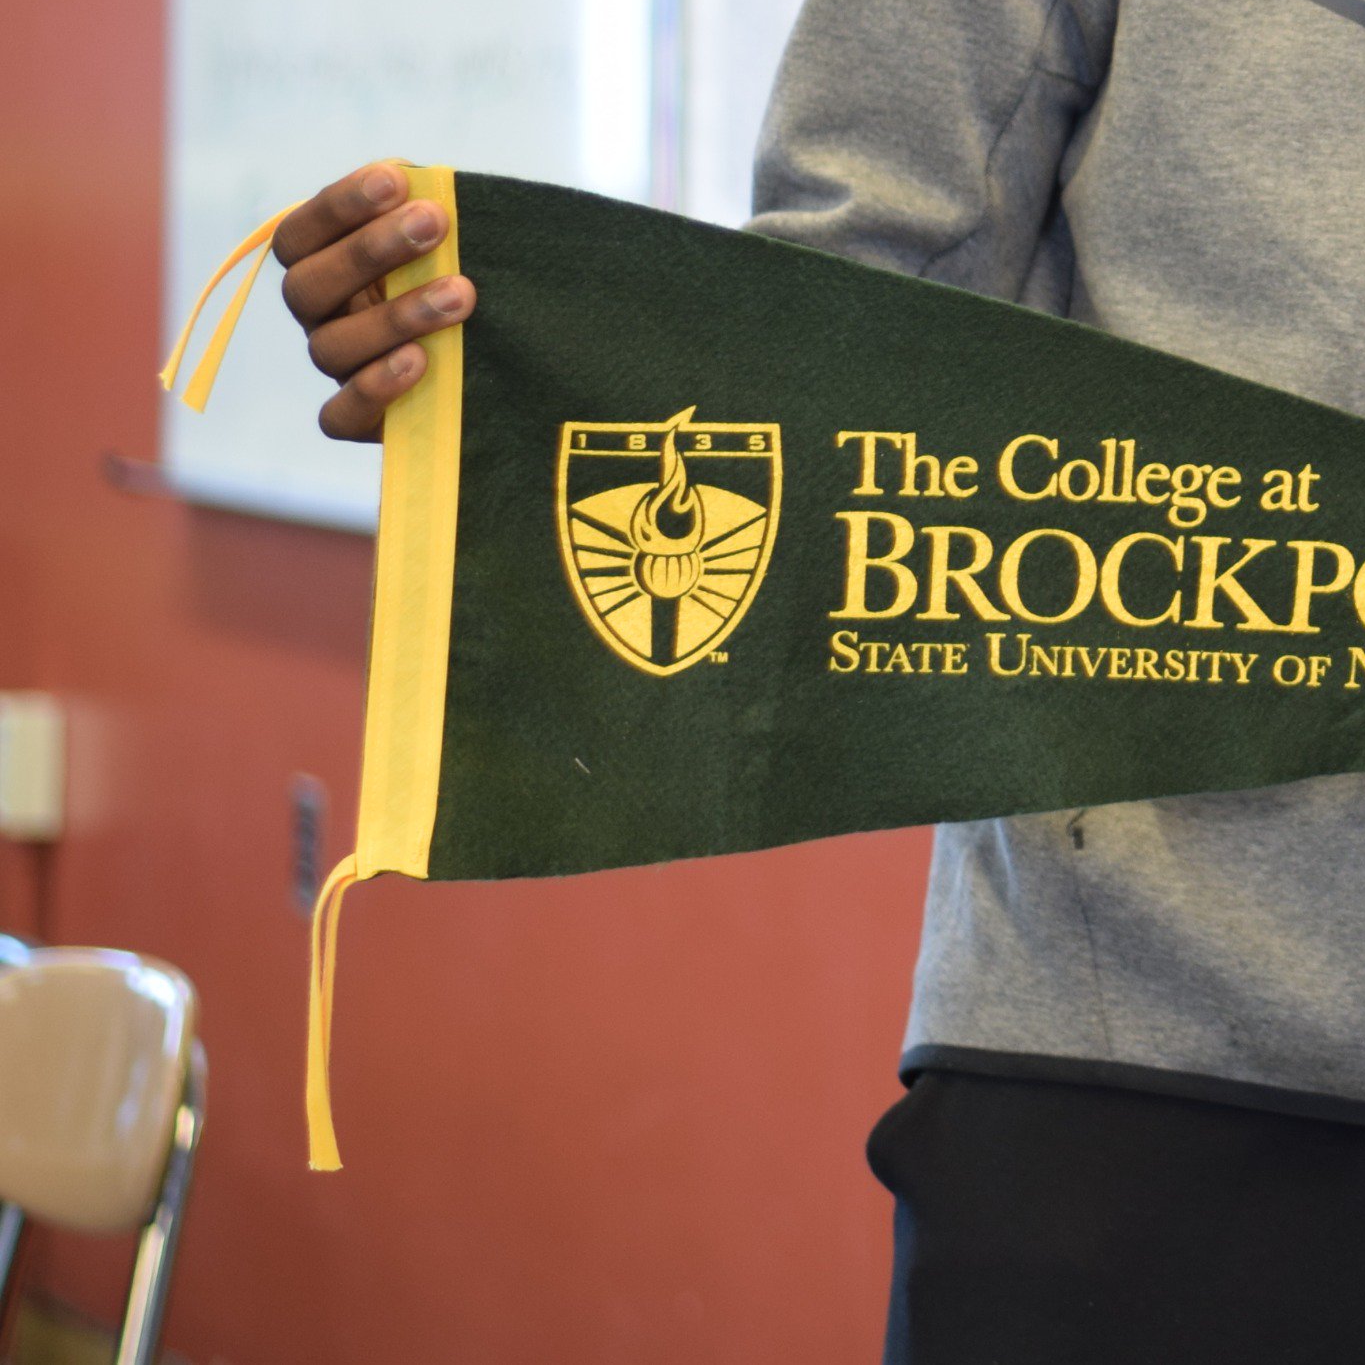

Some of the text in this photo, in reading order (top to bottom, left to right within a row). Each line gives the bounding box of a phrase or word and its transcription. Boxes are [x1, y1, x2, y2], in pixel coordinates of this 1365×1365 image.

[836, 430, 1320, 528] The College at
[828, 630, 969, 675] STATE
[985, 633, 1260, 684] UNIVERSITY
[1272, 654, 1332, 688] OF
